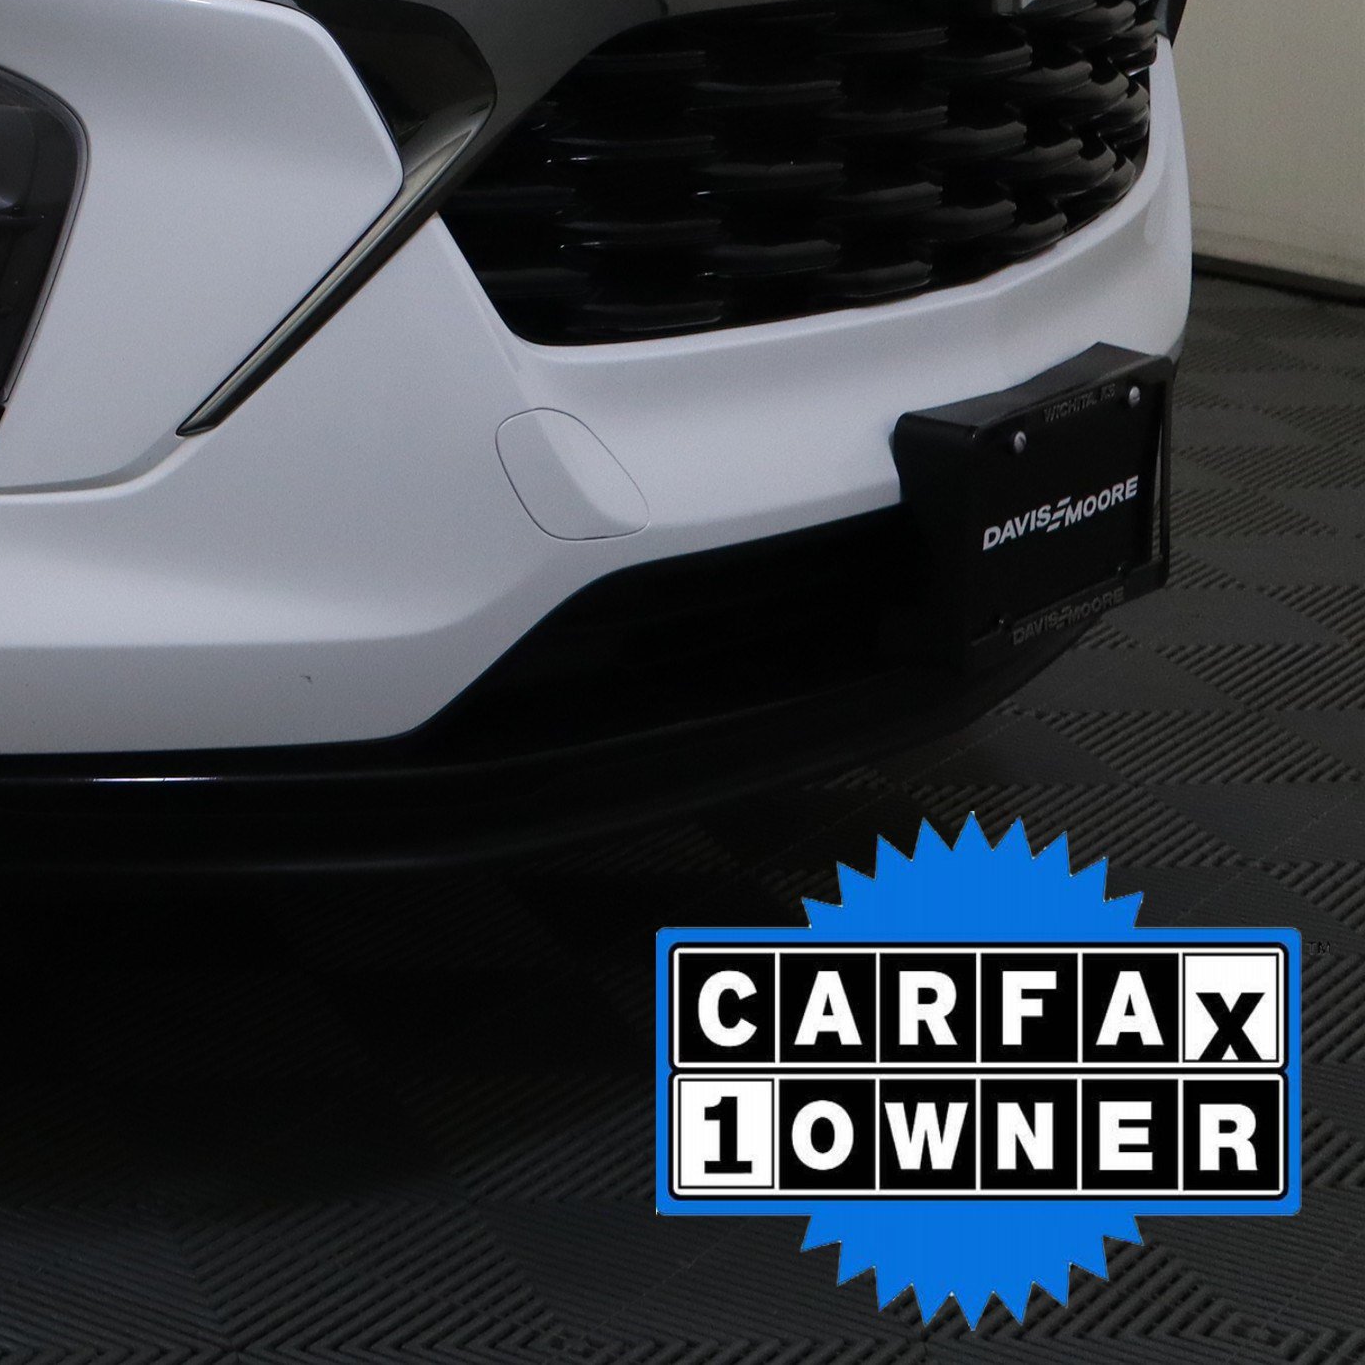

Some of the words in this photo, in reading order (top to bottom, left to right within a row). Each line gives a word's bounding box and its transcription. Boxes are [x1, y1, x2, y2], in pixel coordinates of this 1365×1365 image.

[982, 503, 1053, 552] DAVIS
[1063, 475, 1140, 528] MOORE
[1013, 610, 1059, 646] DAVIS
[1068, 585, 1125, 623] MOORE
